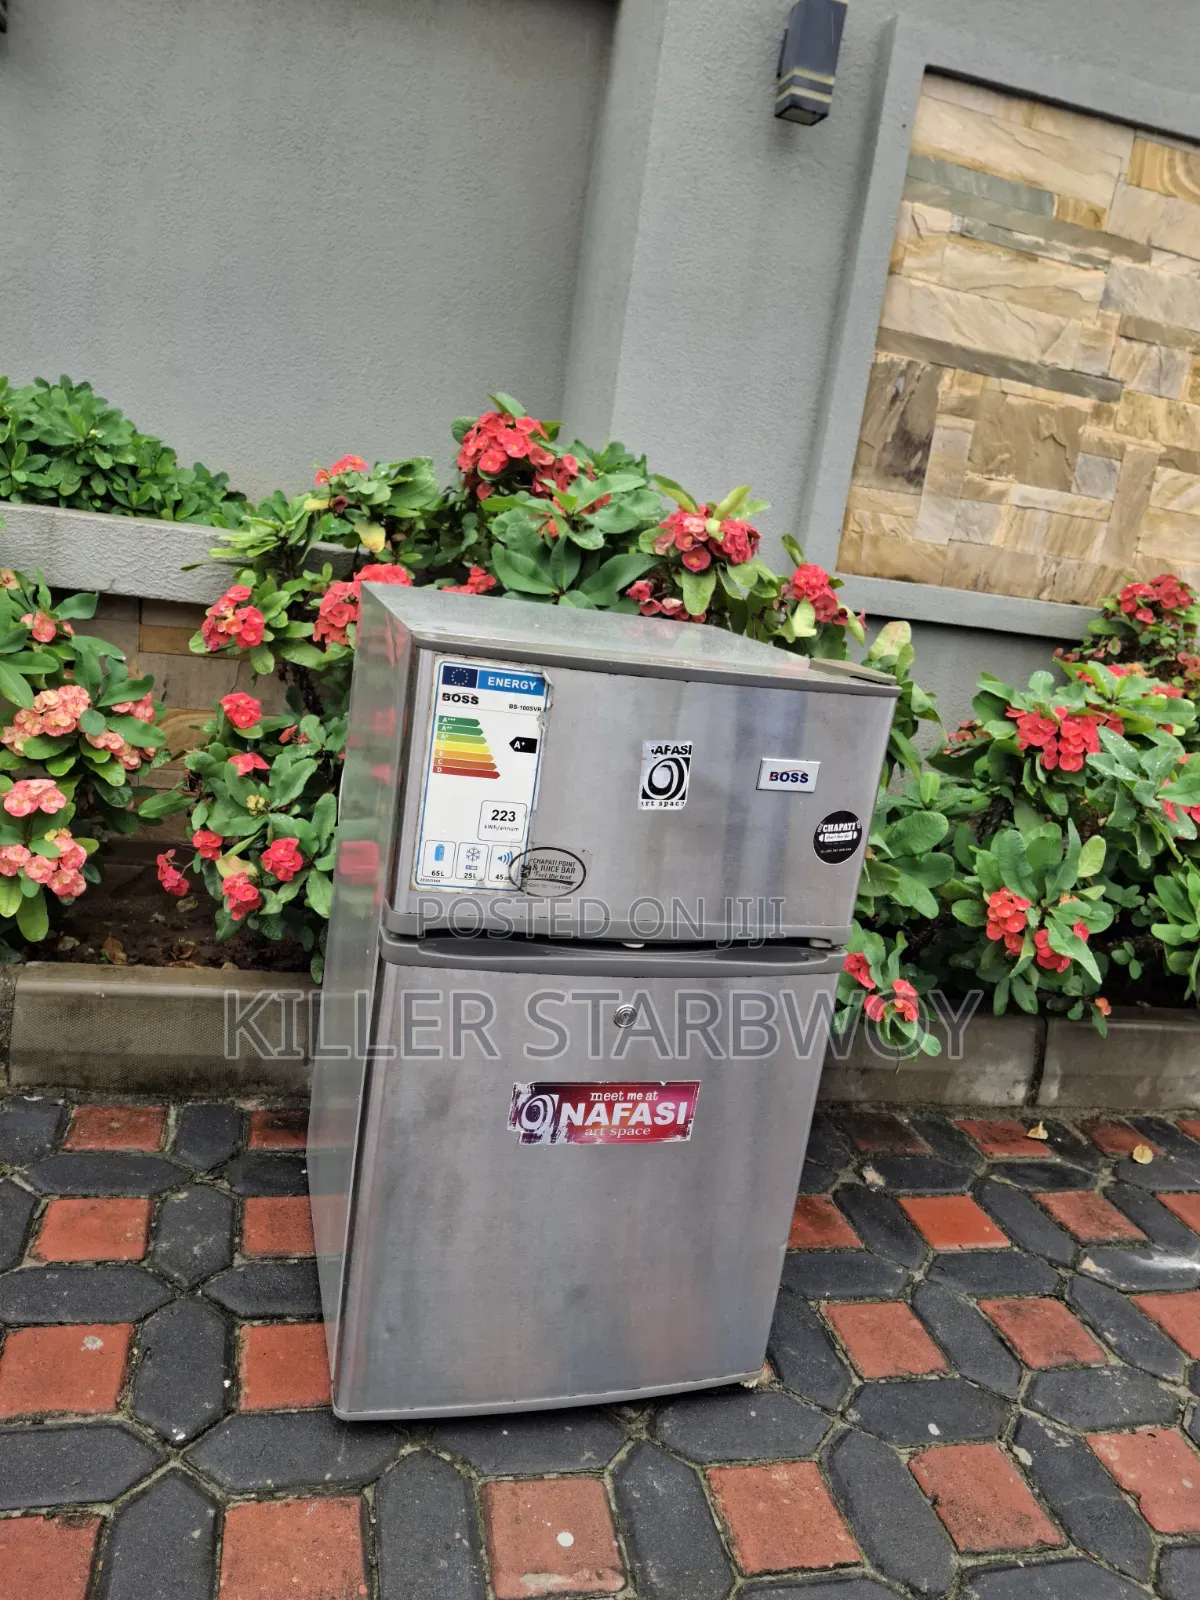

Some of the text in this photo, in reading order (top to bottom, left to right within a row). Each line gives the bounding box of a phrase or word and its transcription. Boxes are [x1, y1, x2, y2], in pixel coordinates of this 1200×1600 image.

[487, 676, 537, 691] ENERGY
[441, 692, 479, 705] BOSS
[513, 740, 526, 749] A+
[769, 771, 809, 784] BOSS
[491, 809, 516, 822] 223
[822, 822, 856, 833] CHAPATI
[532, 858, 576, 868] CHAPATI POINT
[540, 865, 560, 873] JUICE
[560, 867, 576, 875] BAR
[590, 1090, 659, 1101] meet me at
[558, 1102, 688, 1126] NAFASI
[584, 1127, 651, 1139] art space
